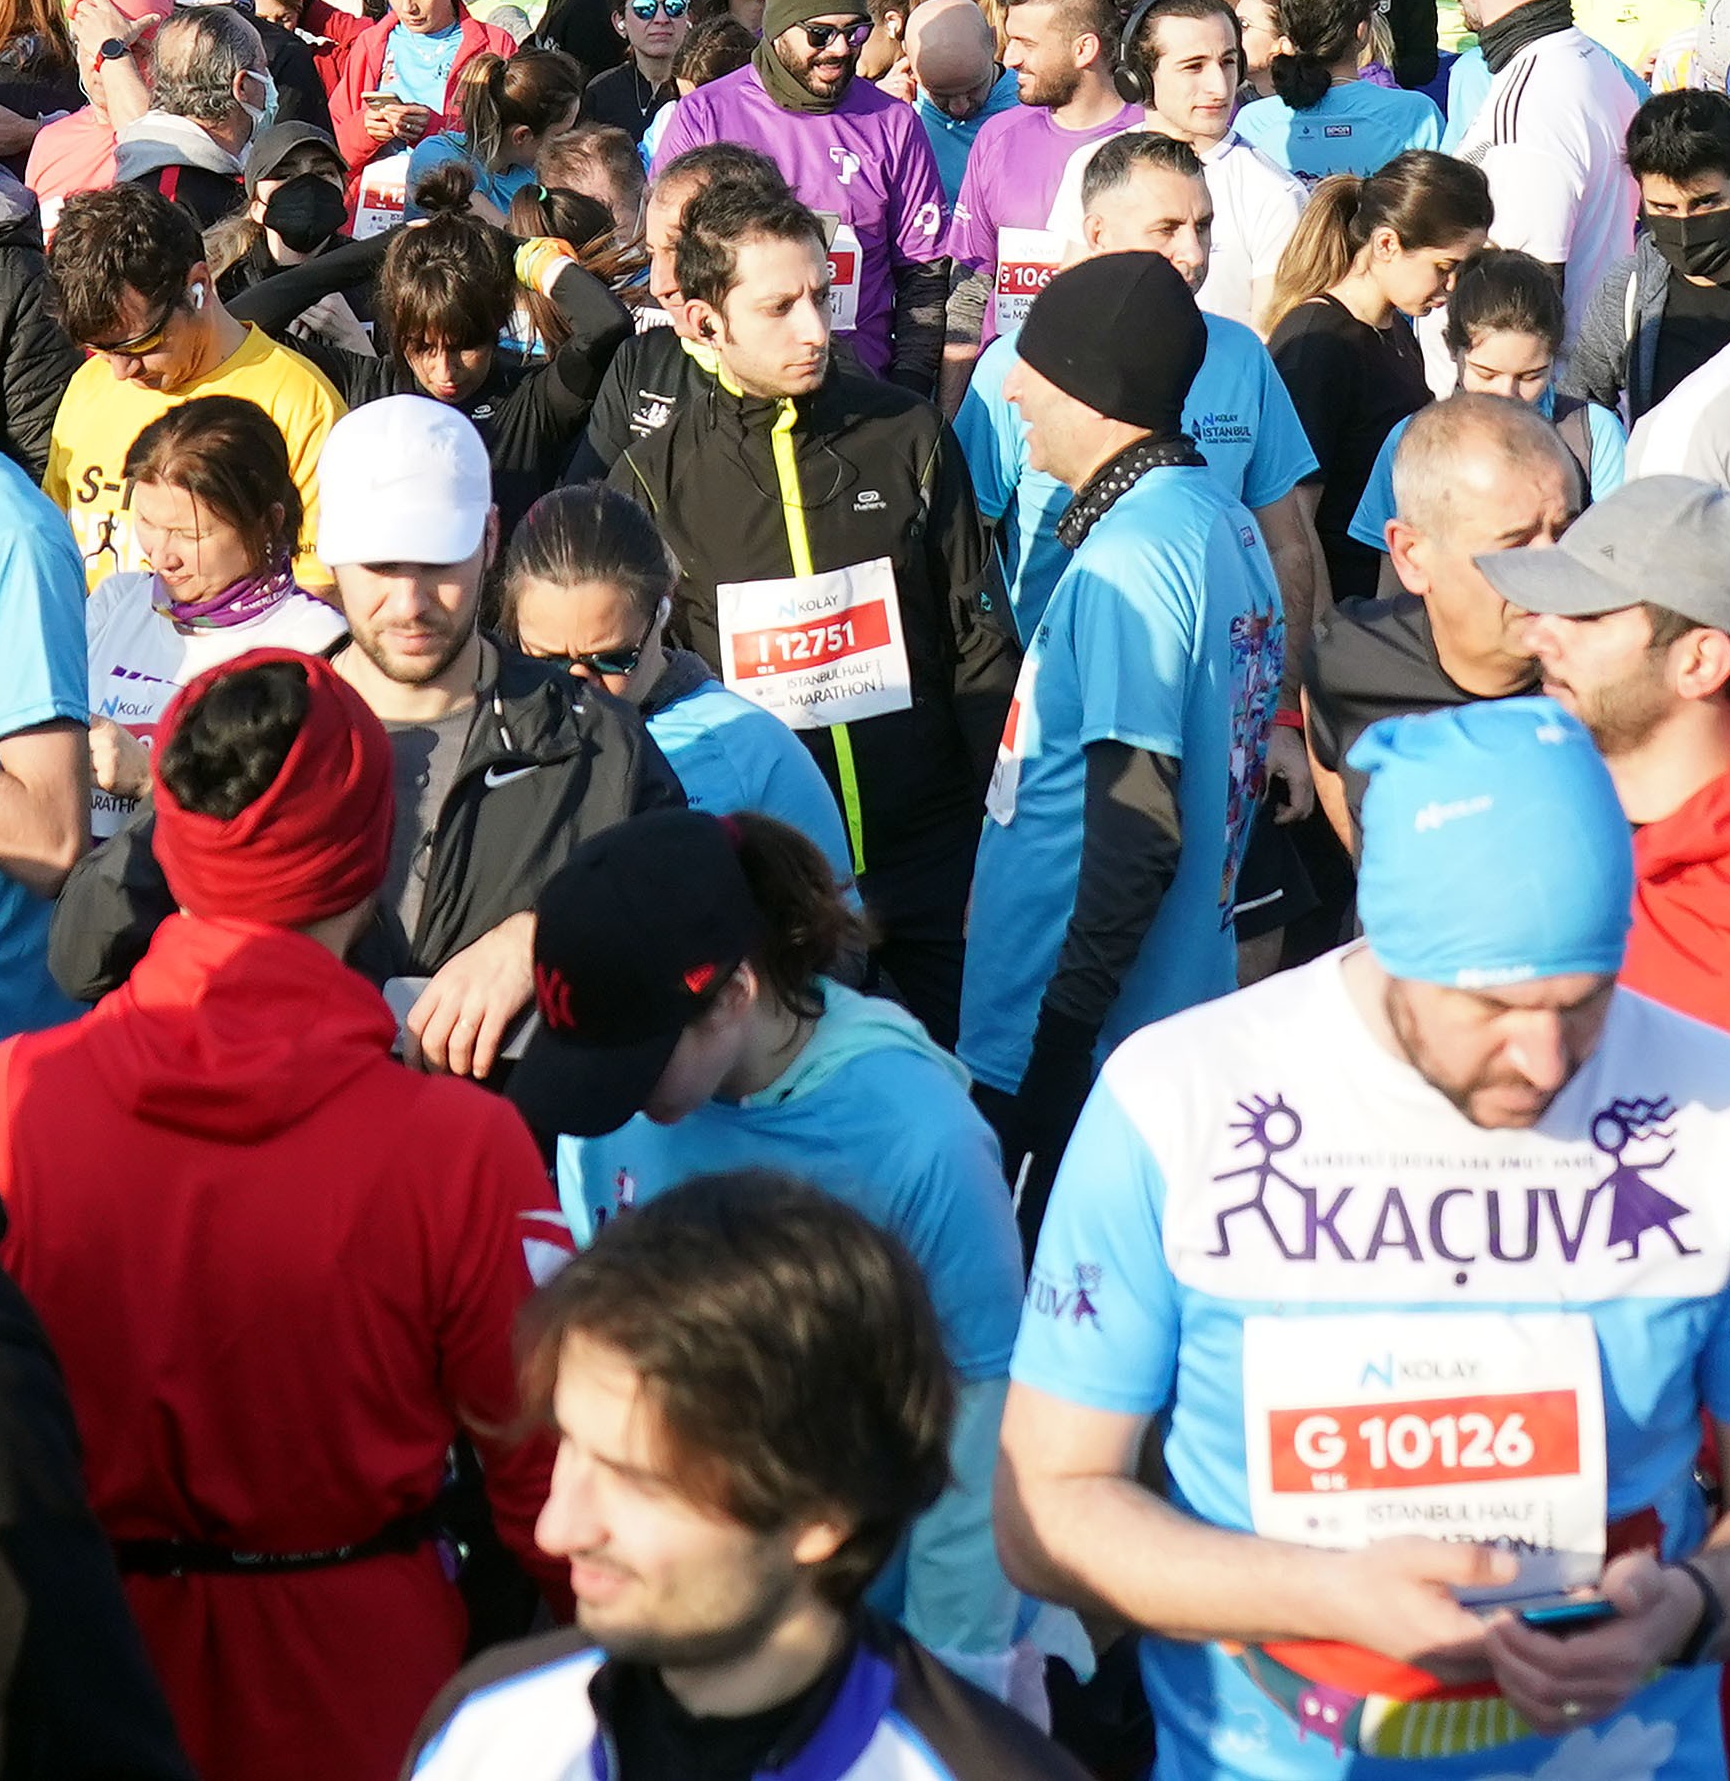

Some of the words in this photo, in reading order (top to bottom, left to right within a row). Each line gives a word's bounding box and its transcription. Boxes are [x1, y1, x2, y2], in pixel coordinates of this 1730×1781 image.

[798, 595, 840, 613] KOLAY
[775, 619, 856, 662] 12751
[787, 665, 840, 687] ISTANBUL
[841, 660, 872, 678] HALF
[789, 675, 876, 705] MARATHON
[1304, 1186, 1597, 1286] KAÇUV
[1399, 1360, 1480, 1379] KOLAY
[1293, 1415, 1348, 1470] G
[1358, 1412, 1536, 1470] 10126
[1367, 1502, 1467, 1521] ISTANBUL
[1478, 1500, 1535, 1520] HALF
